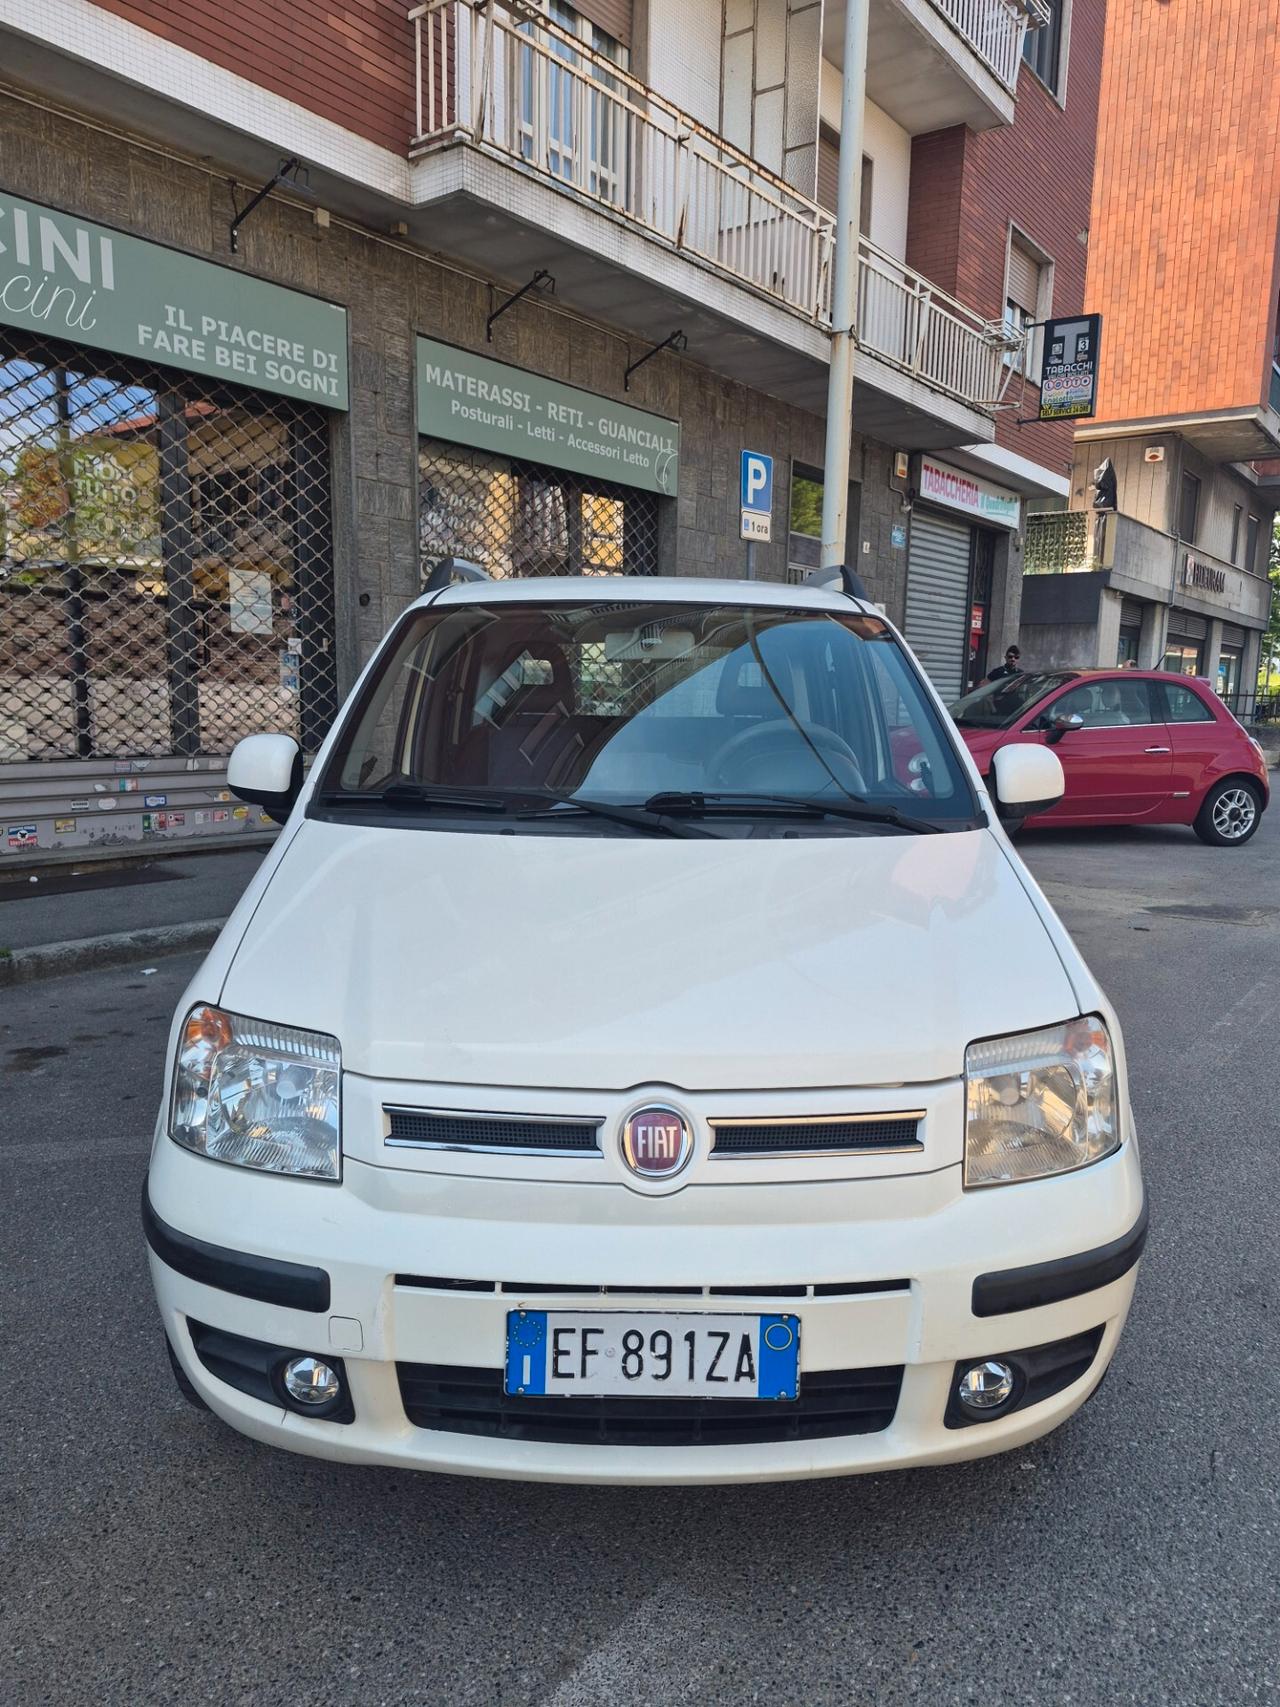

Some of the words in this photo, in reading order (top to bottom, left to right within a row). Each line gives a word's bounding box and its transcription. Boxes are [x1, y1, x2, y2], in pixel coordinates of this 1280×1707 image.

[0, 207, 115, 291] INI
[137, 324, 206, 361] FARE
[215, 346, 257, 376] BEI
[264, 360, 339, 397] SOGNI
[164, 304, 193, 332] IL
[201, 315, 305, 364] PIACERE
[312, 349, 338, 373] DI
[1044, 375, 1091, 391] LOTTO
[1045, 361, 1093, 375] TABACCHI
[426, 363, 531, 412] MATERASSI
[548, 401, 583, 428] RETI
[598, 418, 673, 454] GUANCIALI
[451, 399, 514, 431] Posturali
[527, 421, 556, 442] Letti
[567, 433, 620, 460] Accessori
[623, 449, 649, 468] Letto
[747, 457, 767, 505] P
[923, 464, 980, 508] TABACCHERIA
[637, 1126, 677, 1159] FIAT
[552, 1327, 604, 1379] EF
[621, 1329, 756, 1382] 891ZA
